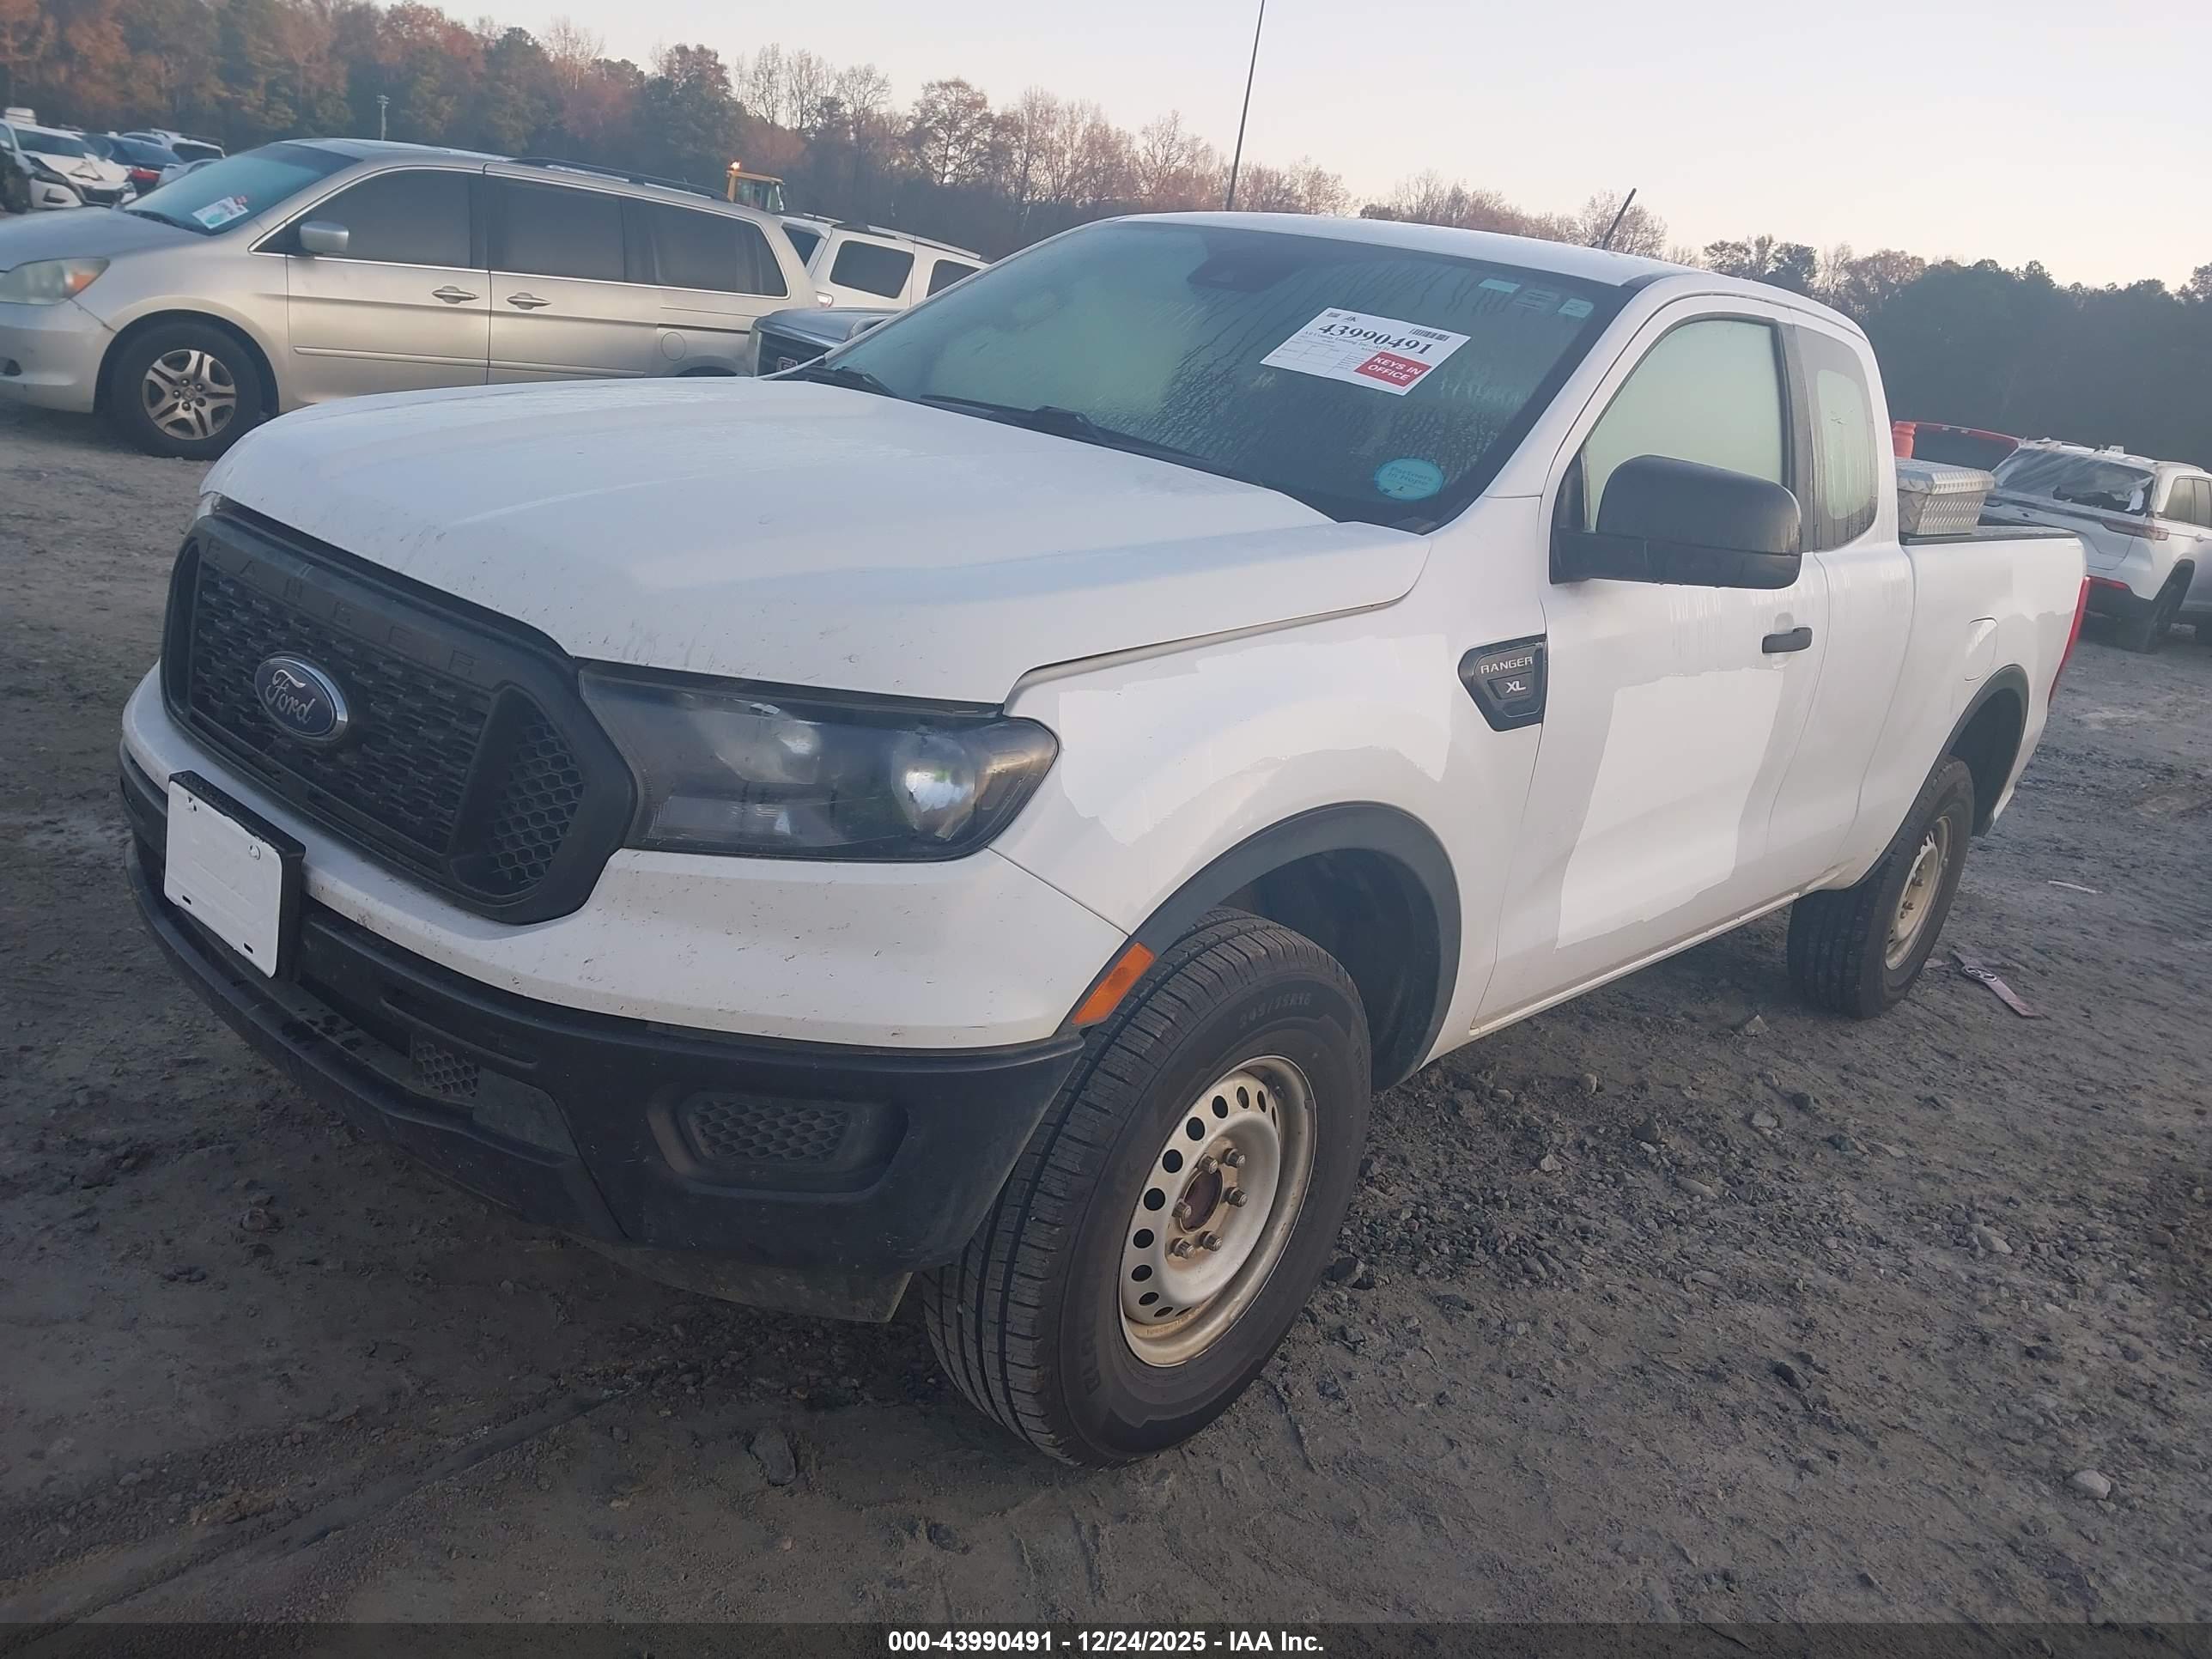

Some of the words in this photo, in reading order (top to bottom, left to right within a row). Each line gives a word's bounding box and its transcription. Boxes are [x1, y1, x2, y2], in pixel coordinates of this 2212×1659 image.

[1318, 323, 1434, 355] 43990491
[1367, 364, 1411, 381] OFFICE
[1373, 356, 1406, 370] KEYS
[1407, 367, 1423, 375] IN
[1480, 656, 1533, 674] RANGER
[1504, 680, 1527, 694] XL
[264, 669, 316, 725] Ford
